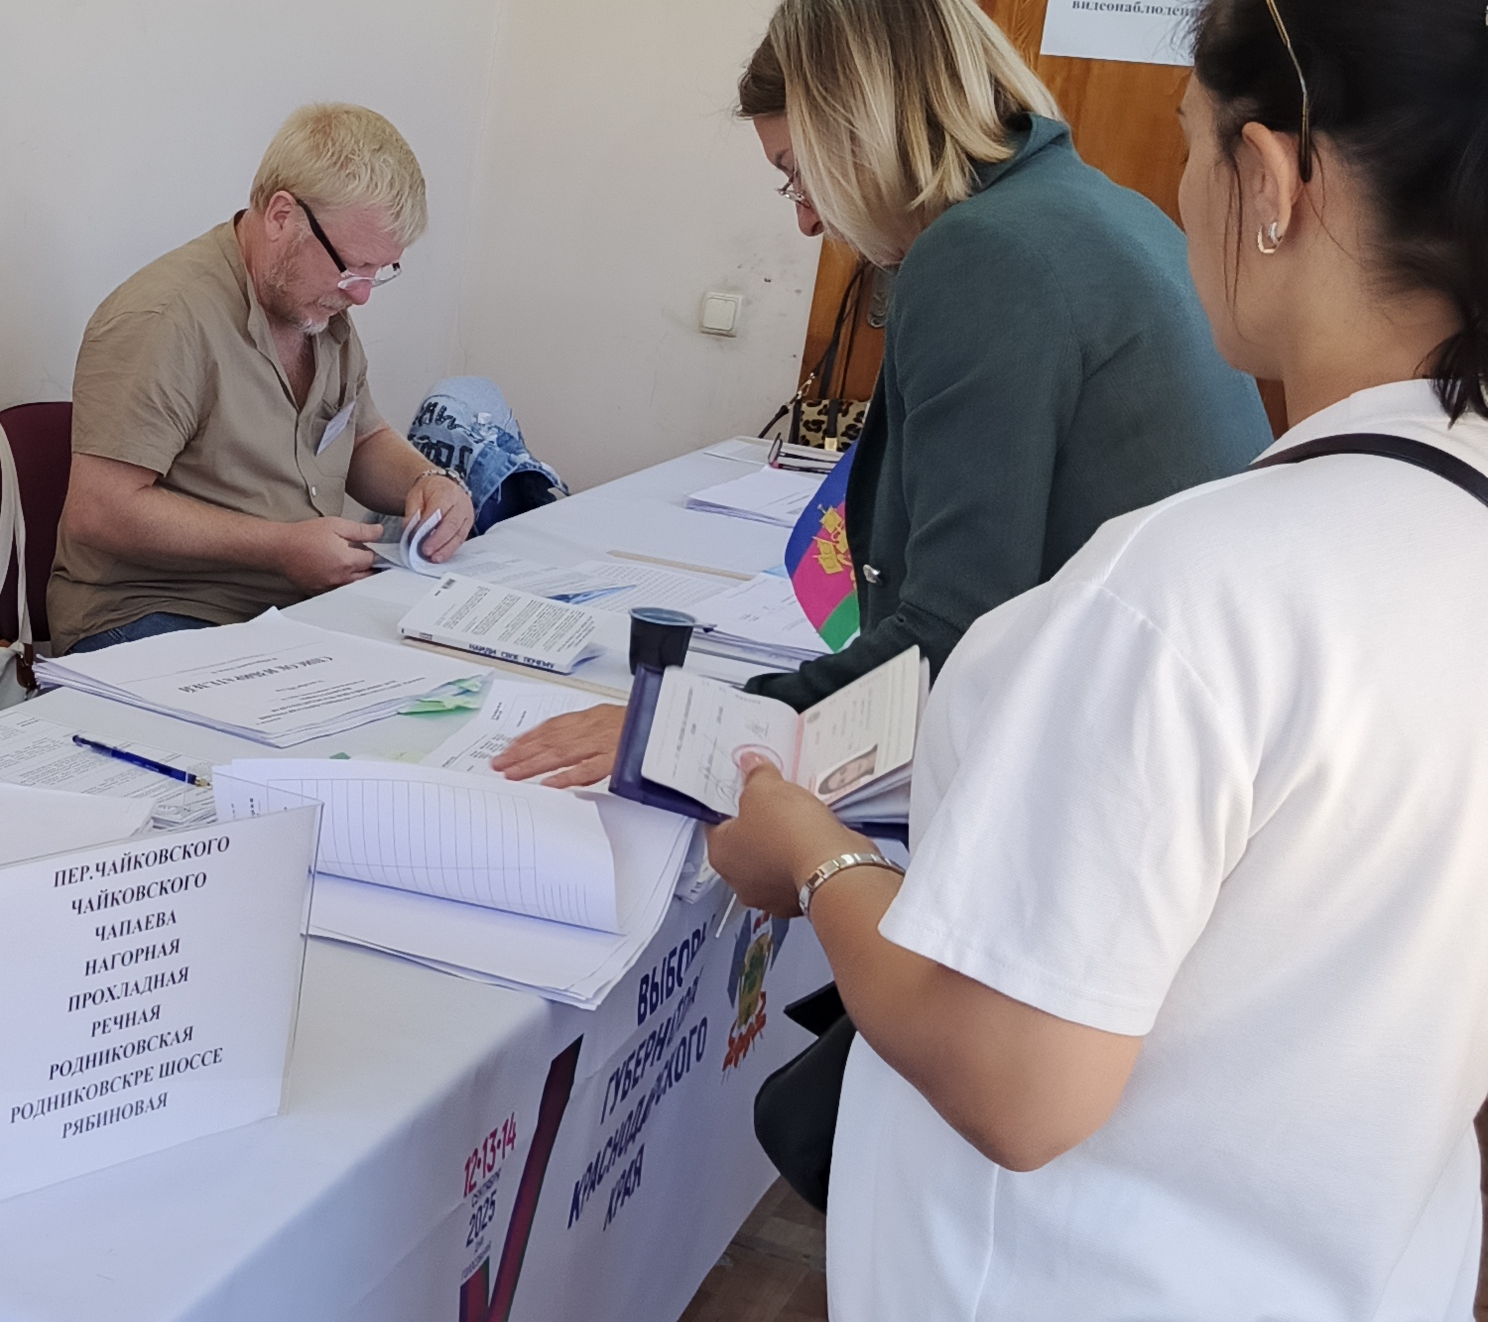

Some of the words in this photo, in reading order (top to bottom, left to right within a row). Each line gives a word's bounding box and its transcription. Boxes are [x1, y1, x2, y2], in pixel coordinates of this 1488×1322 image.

[71, 872, 207, 915] ЧАЙКОВСКОГО
[95, 910, 177, 941] ЧАПАЕВА
[85, 938, 181, 977] НАГОРНАЯ
[67, 966, 190, 1012] ПРОХЛАДНАЯ
[91, 1004, 161, 1038] РЕЧНАЯ
[49, 1025, 194, 1080] РОДНИКОВСКАЯ
[10, 1066, 154, 1124] РОДНИКОВСКРЕ
[158, 1047, 223, 1079] ШОССЕ
[62, 1092, 169, 1139] РЯБИНОВАЯ
[603, 1142, 645, 1232] КРАЯ
[465, 1188, 497, 1248] 2025
